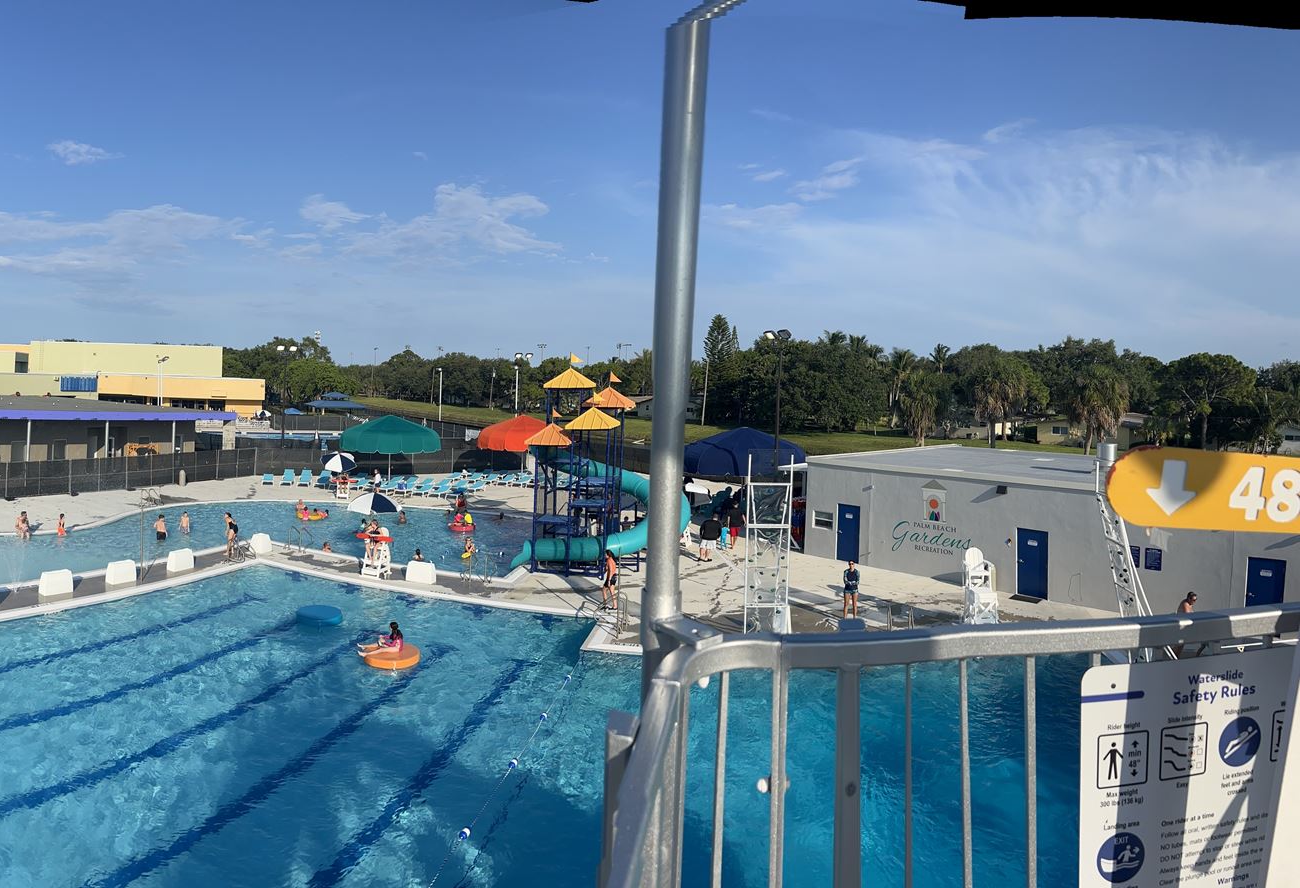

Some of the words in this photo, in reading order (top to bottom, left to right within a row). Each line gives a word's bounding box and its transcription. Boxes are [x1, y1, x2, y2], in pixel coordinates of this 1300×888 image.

[1229, 466, 1300, 522] 48
[933, 525, 956, 533] BEACH
[892, 521, 974, 551] Gardens
[915, 545, 953, 555] RECREATION
[1188, 669, 1244, 685] Waterslide
[1173, 689, 1217, 705] Safety
[1221, 684, 1256, 698] Rules
[1224, 708, 1240, 716] Riding
[1240, 705, 1259, 714] position
[1120, 789, 1138, 797] weight
[1218, 873, 1249, 885] Warnings
